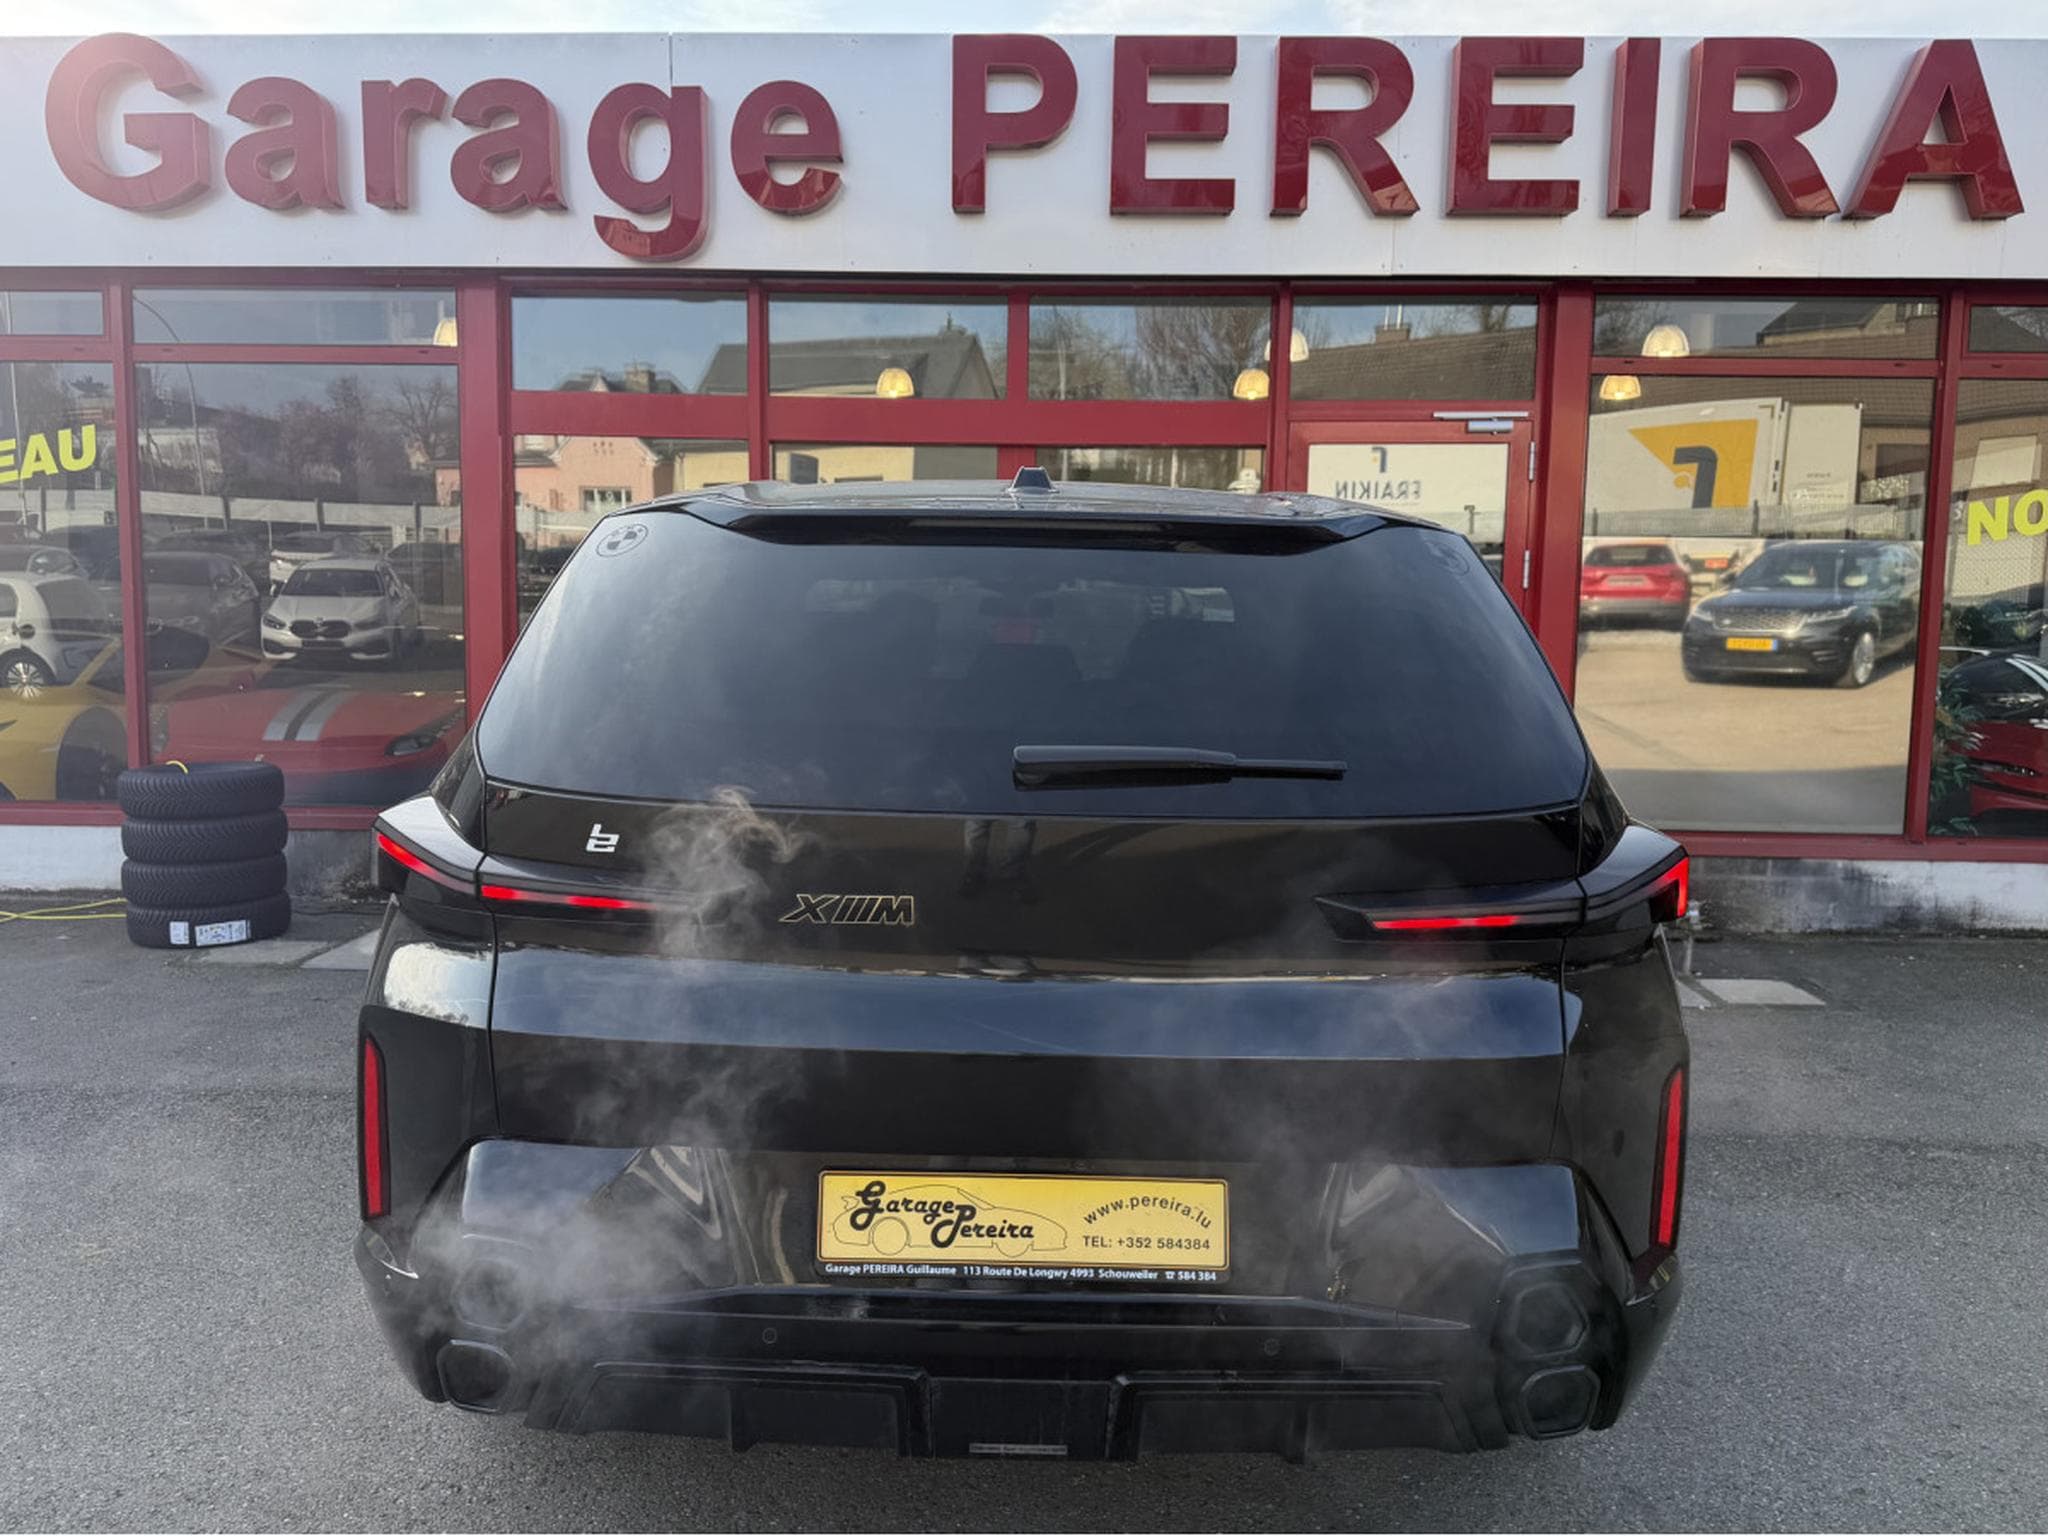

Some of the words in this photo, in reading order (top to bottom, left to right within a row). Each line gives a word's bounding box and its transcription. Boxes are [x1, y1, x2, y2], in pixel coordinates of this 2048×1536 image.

[45, 32, 844, 262] Garage
[951, 34, 2026, 221] PEREIRA
[850, 1180, 955, 1231] Garage
[1083, 1195, 1212, 1229] www.pereira.lu
[930, 1204, 1034, 1248] Pereira
[1083, 1235, 1112, 1248] TEL:
[1117, 1236, 1152, 1249] +352
[1156, 1238, 1210, 1250] 584384
[825, 1263, 861, 1276] Garage
[863, 1264, 904, 1275] PEREIRA
[906, 1264, 957, 1275] Guillaume
[963, 1266, 981, 1276] 113
[983, 1266, 1012, 1276] Route
[1013, 1268, 1028, 1277] De
[1029, 1268, 1068, 1280] Longwy
[1070, 1269, 1094, 1278] 4993
[1177, 1272, 1197, 1281] 584
[1198, 1272, 1217, 1281] 384
